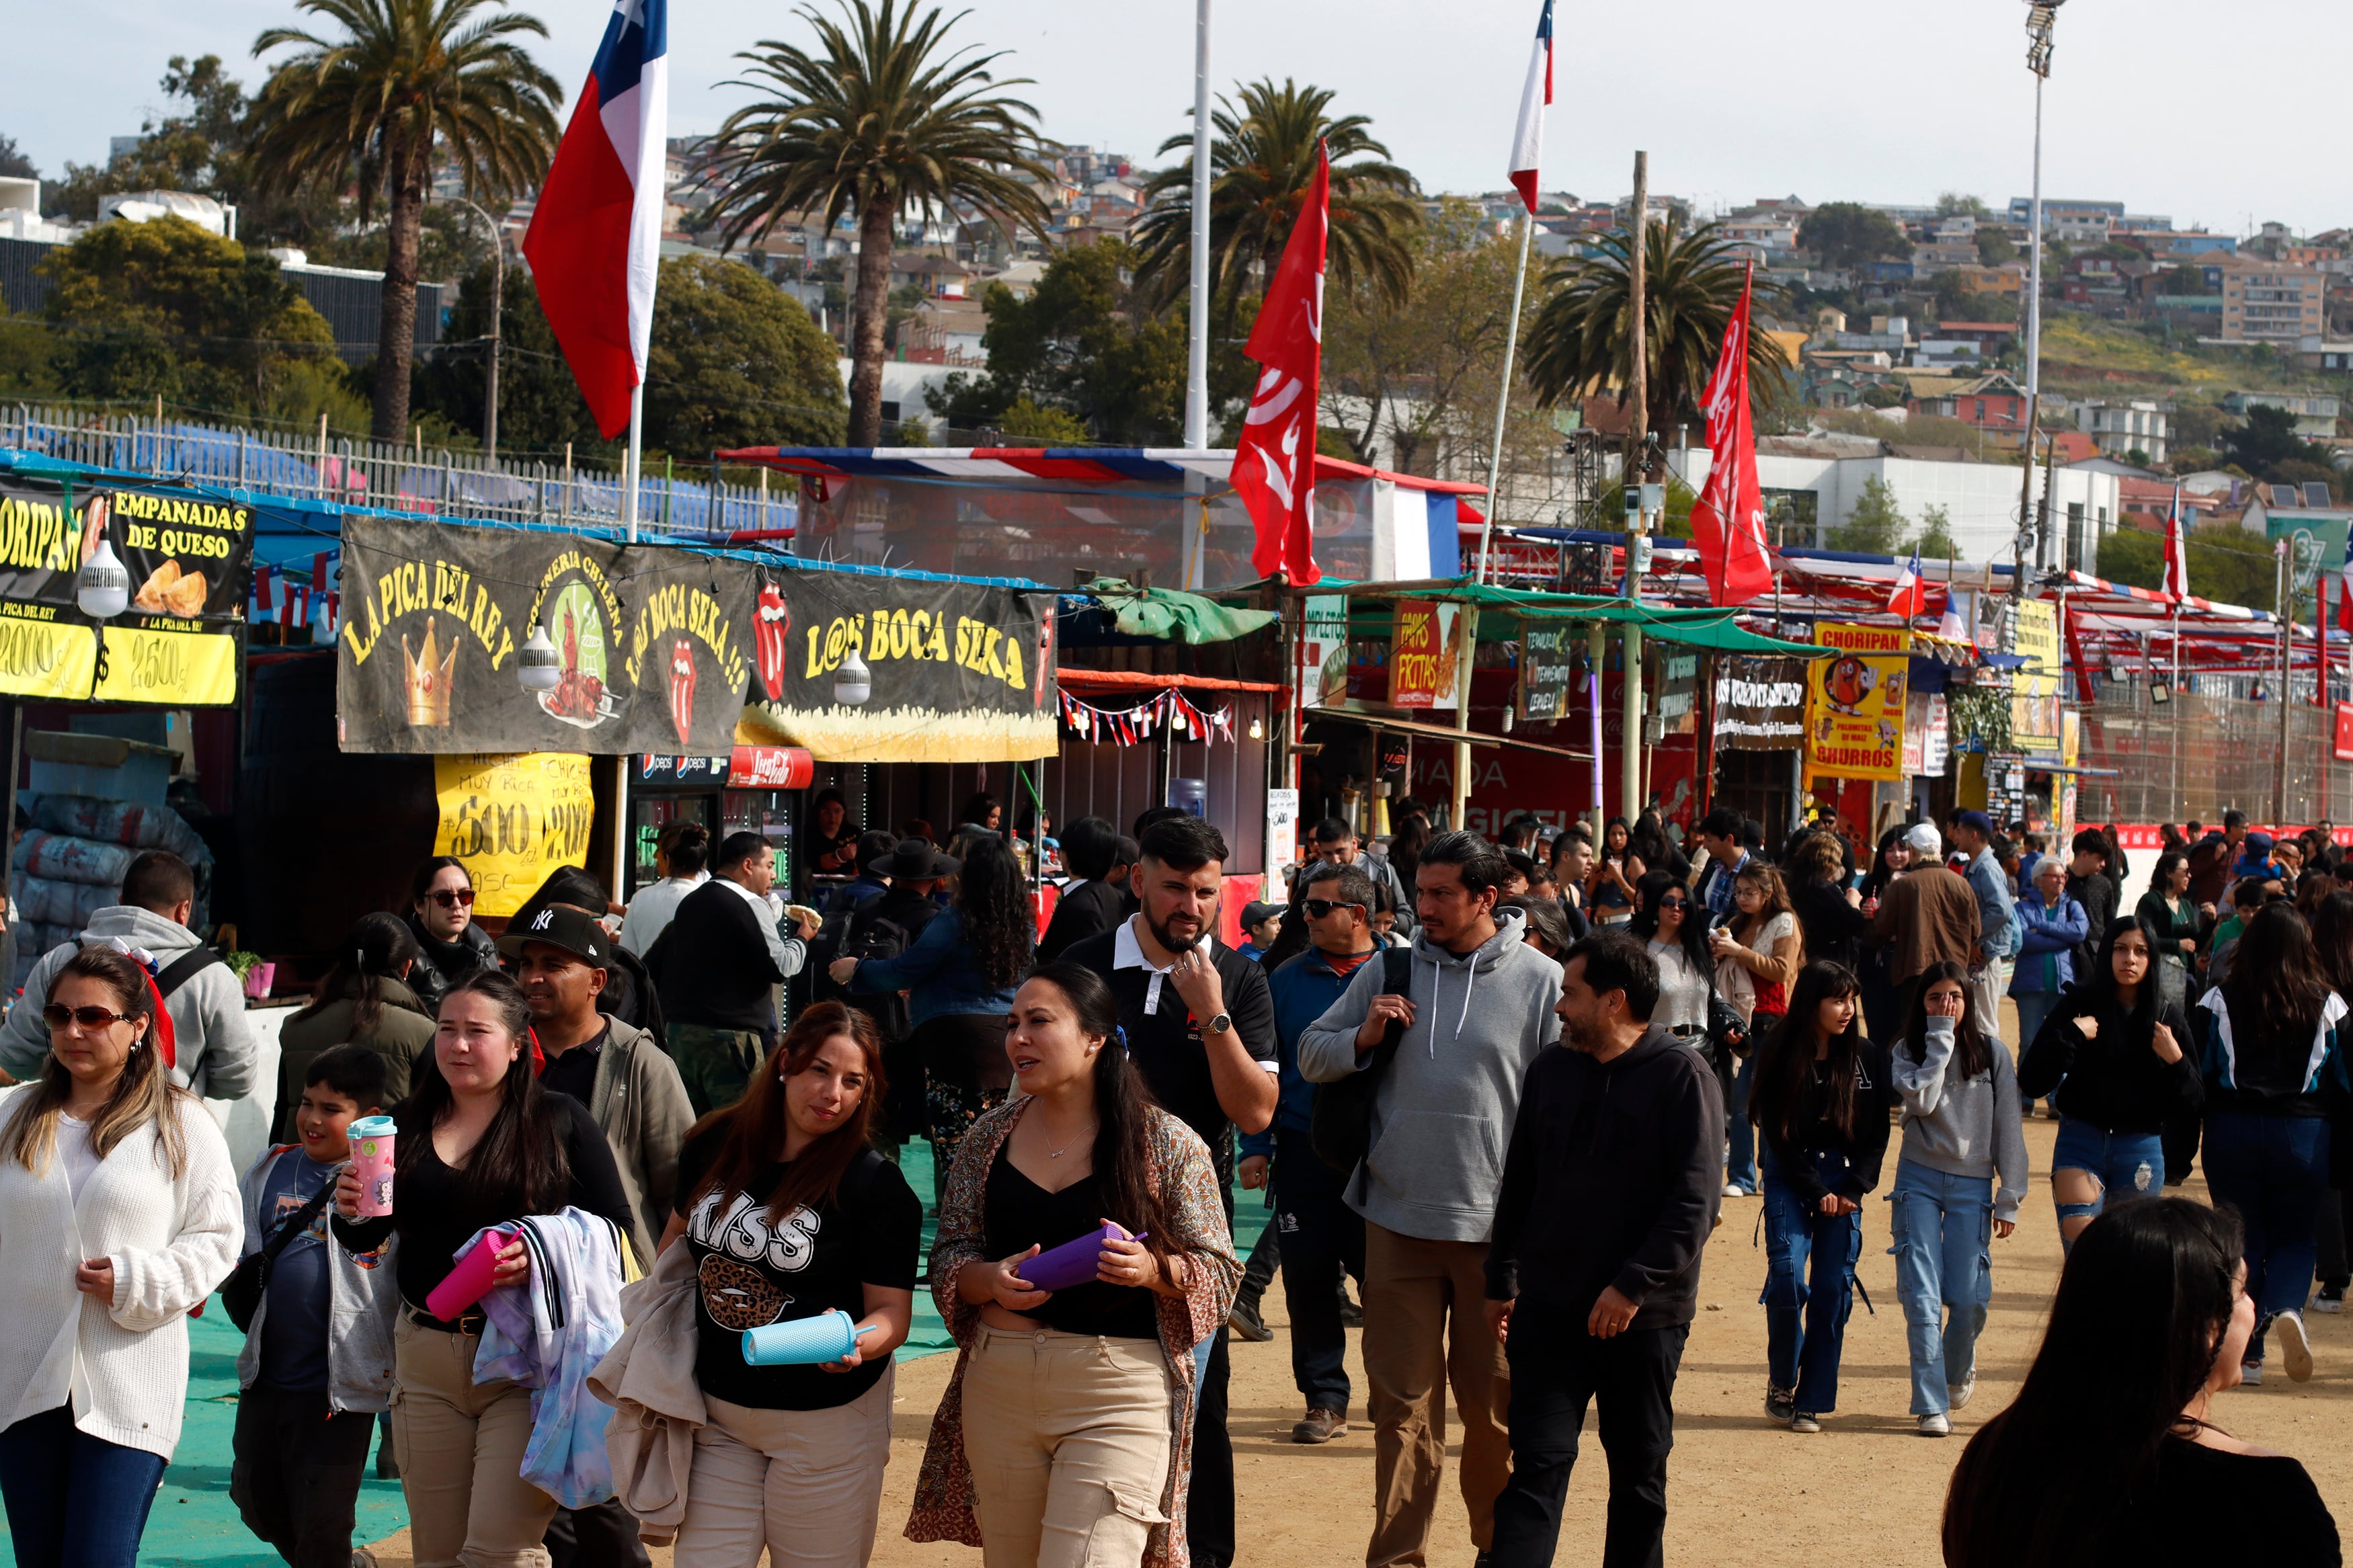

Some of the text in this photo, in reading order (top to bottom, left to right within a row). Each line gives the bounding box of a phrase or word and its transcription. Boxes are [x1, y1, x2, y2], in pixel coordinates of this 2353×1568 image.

[114, 491, 247, 531] EMPANADAS
[126, 524, 230, 559] DE QUESO
[3, 602, 56, 620] PICA DEL REY
[582, 556, 623, 647] CHILENA
[149, 617, 161, 629] LA
[344, 559, 514, 671] LA PICA DEL REY
[649, 583, 686, 640] BOCA
[688, 588, 729, 665] SEKA
[1402, 613, 1430, 649] PAPAS
[1823, 630, 1901, 651] CHORIPAN
[805, 608, 1027, 690] L@S BOCA SEKA
[131, 634, 180, 691] 2500
[1398, 654, 1437, 689] FRITAS
[1883, 708, 1903, 717] JUGOS
[1837, 723, 1872, 733] PALOMITAS
[655, 755, 672, 771] pepsi
[688, 756, 706, 772] pepsi
[1817, 746, 1894, 768] CHURROS
[458, 774, 493, 791] MUY
[451, 795, 530, 858] 500
[469, 869, 515, 894] ASO
[531, 909, 554, 930] NY
